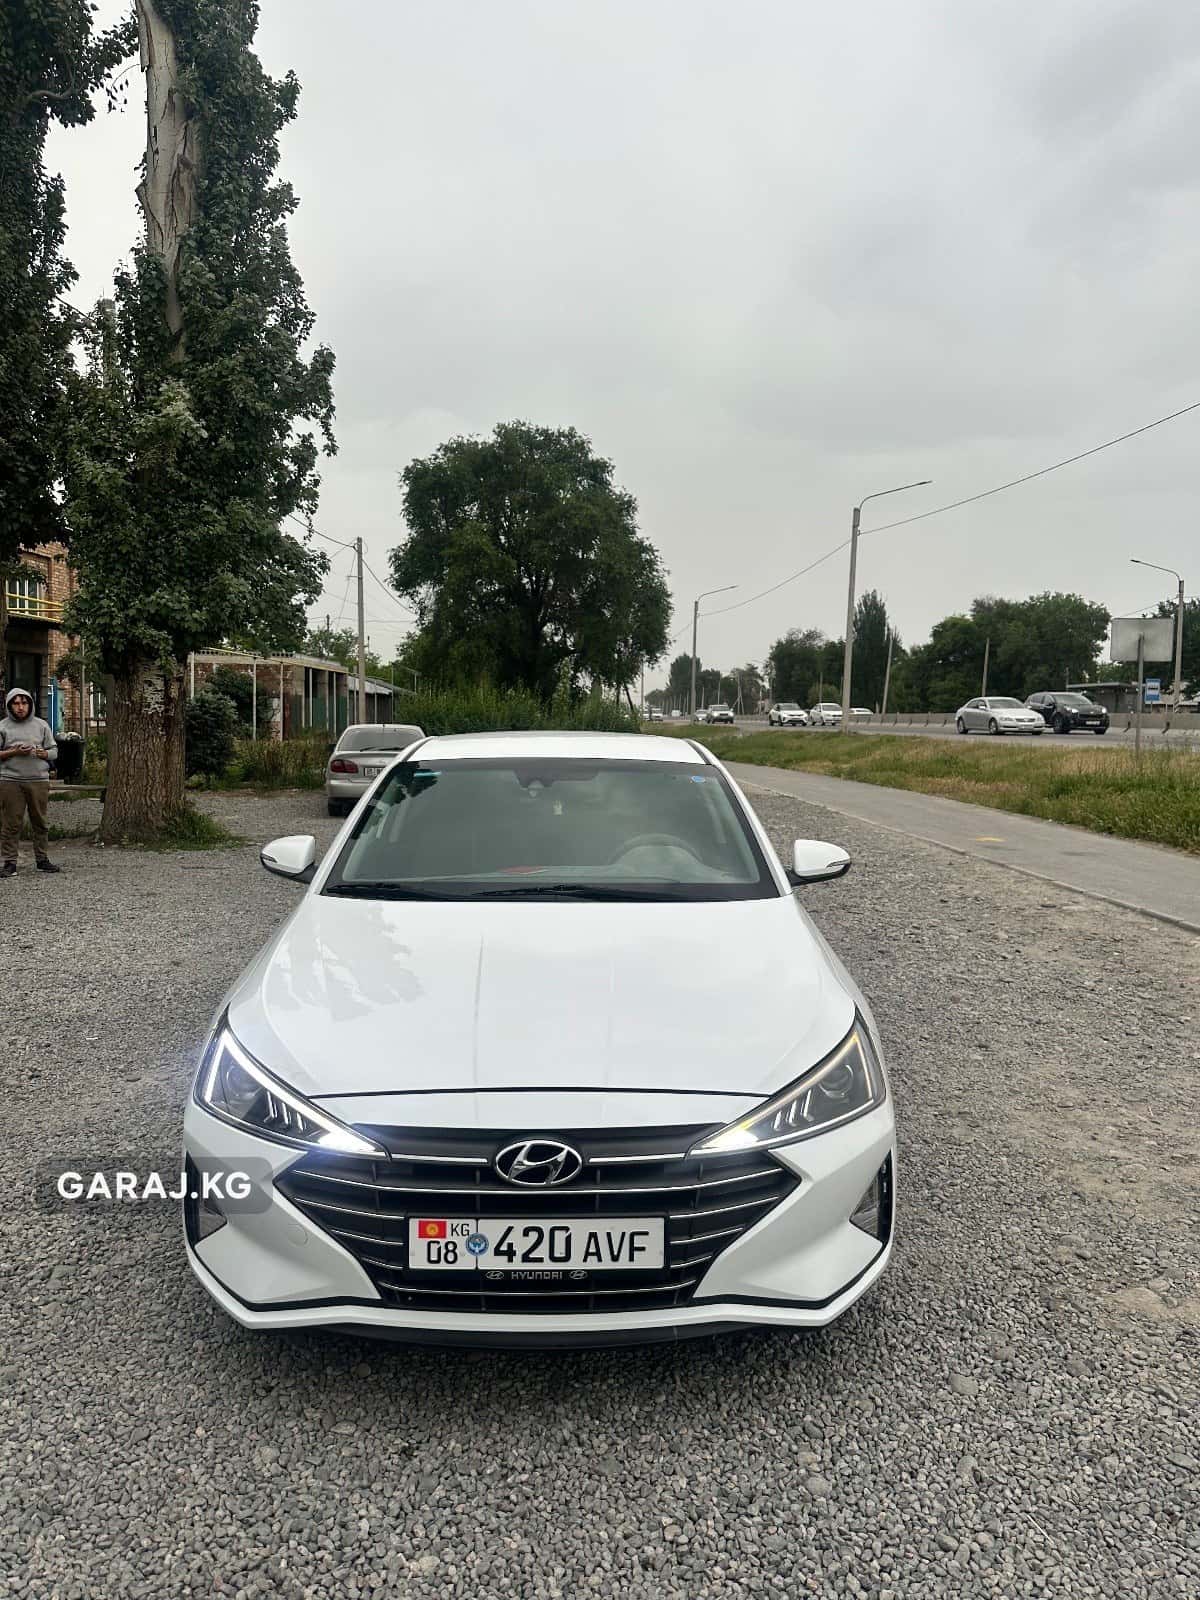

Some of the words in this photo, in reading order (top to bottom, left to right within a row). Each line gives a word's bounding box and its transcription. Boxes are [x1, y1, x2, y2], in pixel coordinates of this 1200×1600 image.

[450, 1222, 470, 1237] KG
[426, 1240, 459, 1265] 08
[493, 1225, 572, 1263] 420
[582, 1230, 650, 1263] AVF
[511, 1270, 563, 1280] HYUNDAI
